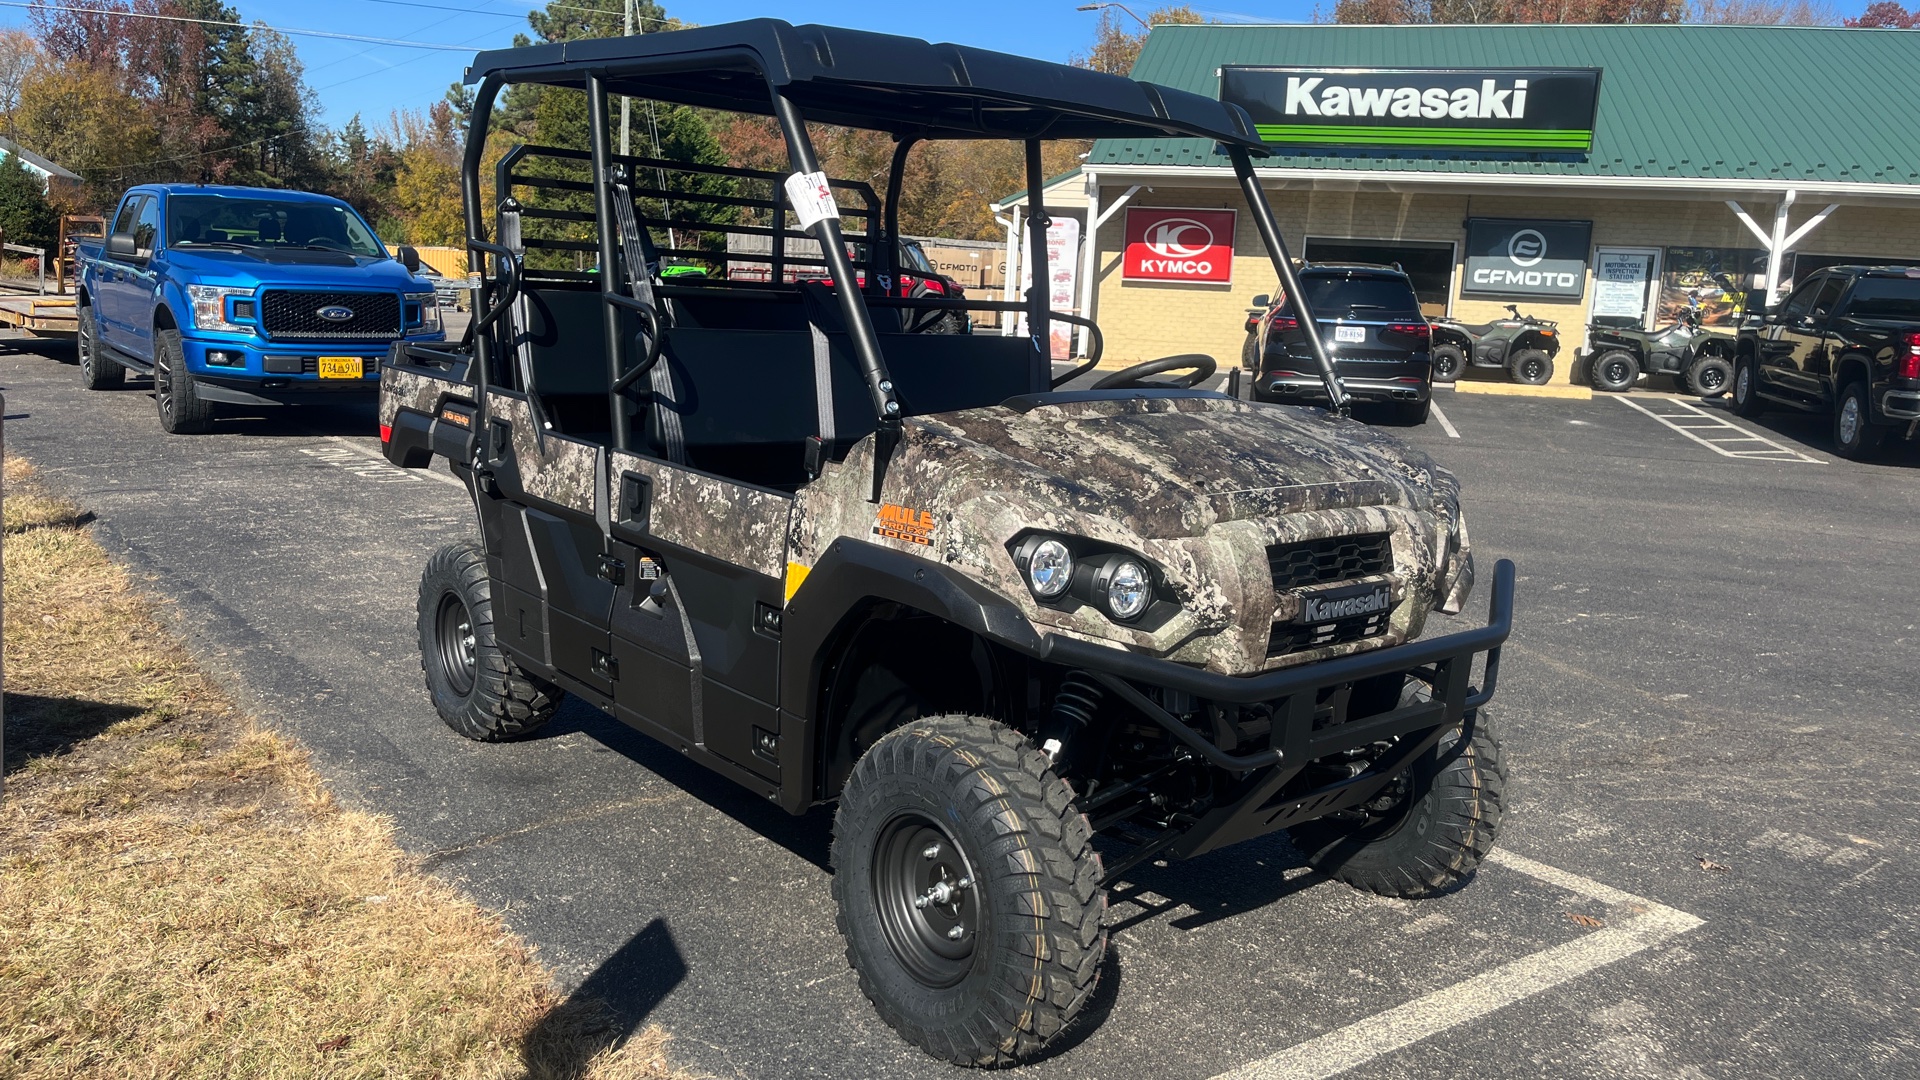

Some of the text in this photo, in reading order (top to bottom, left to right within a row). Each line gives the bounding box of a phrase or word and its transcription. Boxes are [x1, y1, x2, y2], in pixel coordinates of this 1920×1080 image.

[1285, 77, 1528, 119] Kawasaki
[940, 263, 977, 272] CFMOTO
[1140, 259, 1212, 275] KYMCO
[1473, 268, 1575, 288] CFMOTO
[877, 503, 935, 530] MULE
[878, 528, 930, 546] 1000
[1305, 586, 1390, 622] Kawasaki
